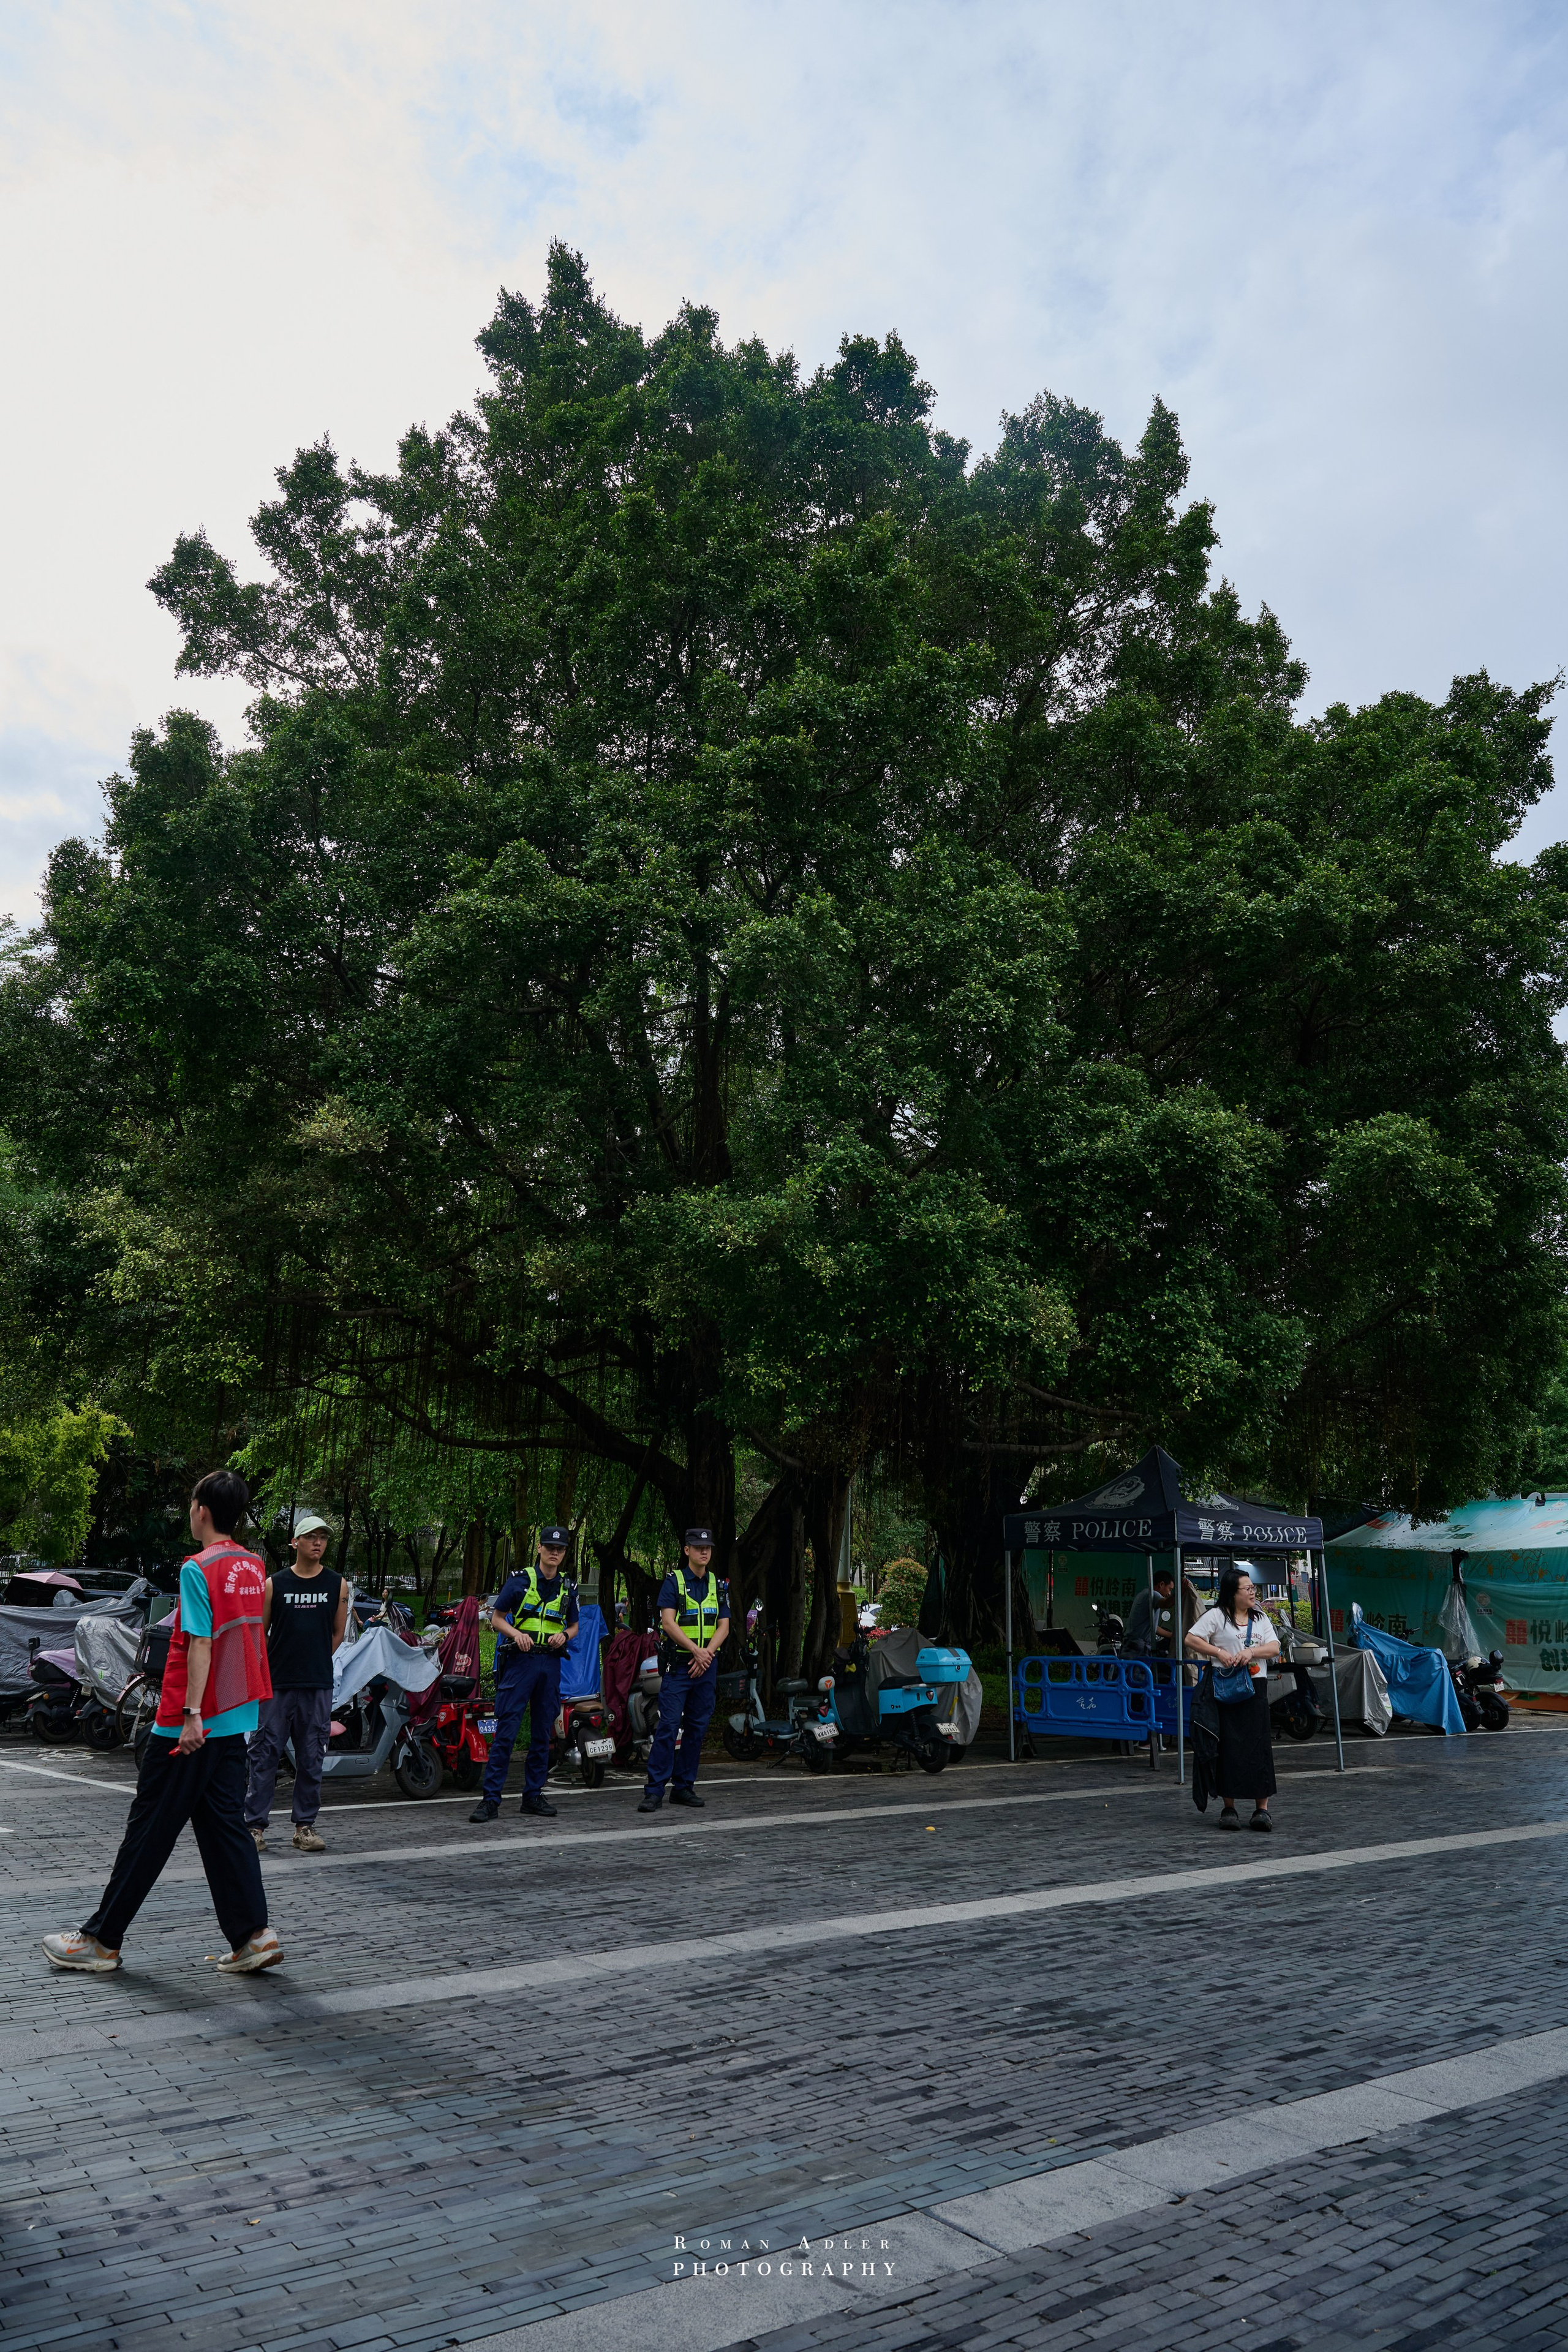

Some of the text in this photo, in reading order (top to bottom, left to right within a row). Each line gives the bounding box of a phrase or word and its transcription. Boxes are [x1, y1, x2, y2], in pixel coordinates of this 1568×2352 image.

[1023, 1519, 1152, 1544] 警察 POLICE
[1197, 1518, 1308, 1544] 警察 POLICE
[589, 1744, 612, 1753] CE1239
